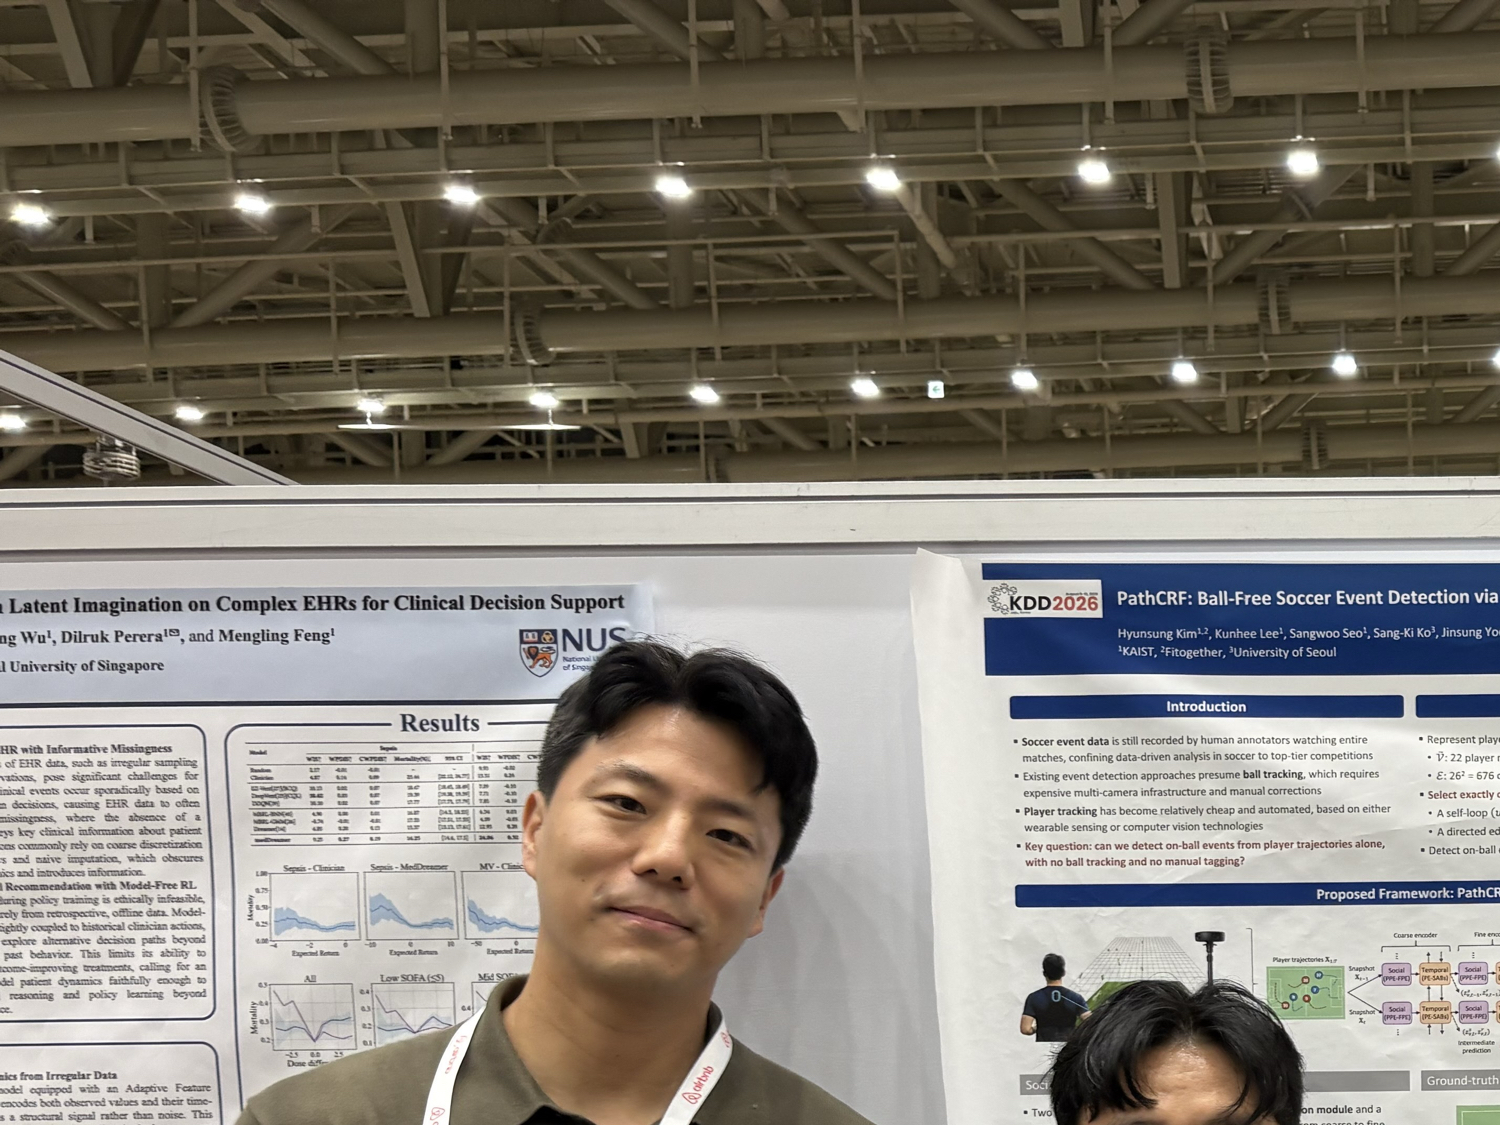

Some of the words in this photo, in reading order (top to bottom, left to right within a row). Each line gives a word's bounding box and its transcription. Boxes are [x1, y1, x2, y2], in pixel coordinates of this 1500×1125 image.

[1010, 596, 1098, 611] KDD2026
[1117, 590, 1192, 606] PathCRF:
[1197, 590, 1271, 606] Ball-Free
[1276, 590, 1331, 605] Soccer
[1336, 590, 1383, 605] Event
[1388, 589, 1469, 604] Detection
[1474, 588, 1498, 604] via
[9, 598, 68, 614] Latent
[73, 596, 183, 615] Imagination
[187, 600, 210, 612] on
[215, 595, 297, 614] Complex
[302, 595, 356, 611] EHRs
[361, 595, 389, 611] for
[393, 594, 464, 611] Clinical
[469, 594, 545, 610] Decision
[550, 594, 624, 613] Support
[61, 630, 109, 643] Dilruk
[188, 629, 214, 642] and
[218, 629, 289, 645] Mengling
[1118, 628, 1173, 641] Hyunsung
[1215, 628, 1257, 639] Kunhee
[1289, 628, 1340, 641] Sangwoo
[1373, 627, 1413, 640] Sang-Ki
[1441, 627, 1482, 640] Jinsung
[1291, 646, 1303, 657] of
[1305, 646, 1336, 657] Seoul
[9, 660, 77, 674] University
[80, 659, 95, 672] of
[97, 659, 164, 674] Singapore
[1167, 701, 1246, 712] Introduction
[399, 713, 479, 732] Results
[1021, 737, 1054, 747] Soccer
[1056, 737, 1085, 746] event
[1087, 736, 1109, 746] data
[1111, 736, 1119, 746] is
[1121, 736, 1138, 746] still
[1140, 735, 1184, 745] recorded
[1186, 735, 1198, 747] by
[1200, 735, 1234, 745] human
[1237, 736, 1290, 745] annotators
[1292, 735, 1336, 746] watching
[1339, 735, 1368, 745] entire
[20, 744, 43, 754] with
[46, 744, 108, 754] Informative
[110, 743, 172, 755] Missingness
[5, 881, 92, 891] Recommendation
[94, 881, 117, 890] with
[119, 880, 178, 890] Model-Free
[180, 880, 197, 890] RL
[1316, 888, 1375, 902] Proposed
[1379, 887, 1453, 899] Framework:
[1414, 932, 1437, 940] encoder
[693, 1065, 714, 1092] airbnb
[1426, 1075, 1499, 1086] Ground-truth
